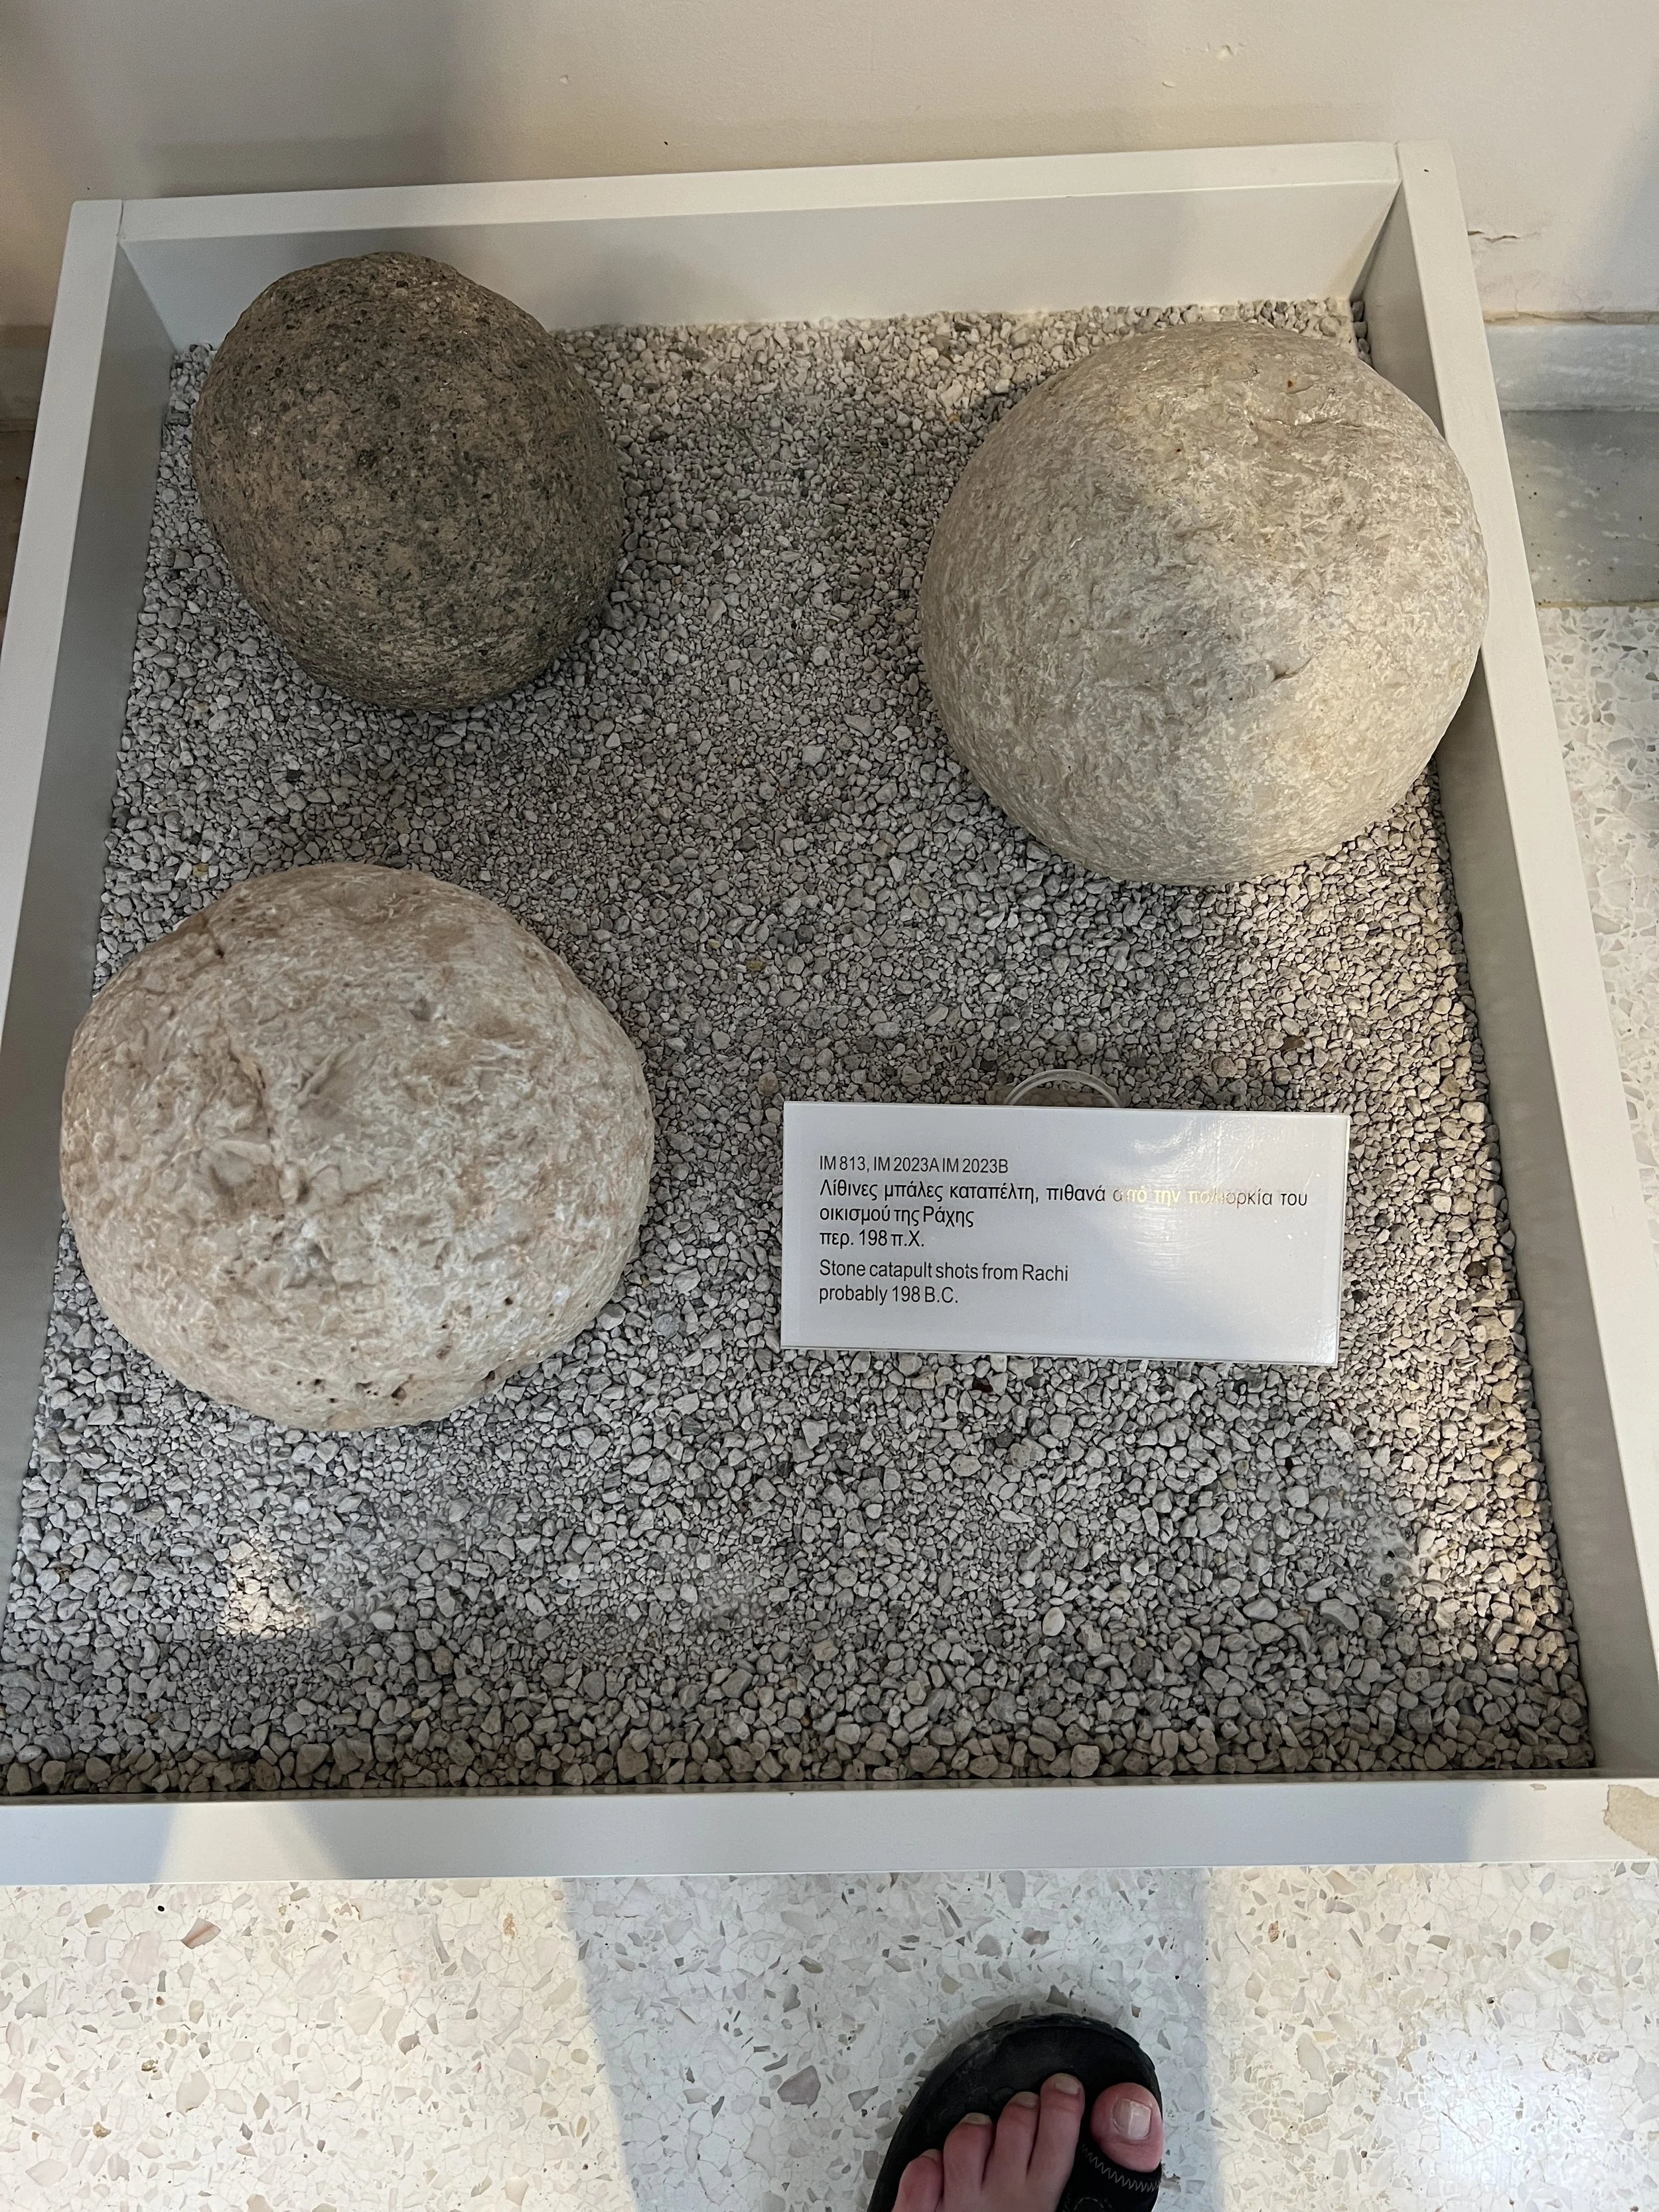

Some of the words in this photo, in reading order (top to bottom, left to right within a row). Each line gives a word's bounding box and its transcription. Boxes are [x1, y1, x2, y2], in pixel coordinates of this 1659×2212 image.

[820, 1156, 836, 1170] IM
[839, 1156, 869, 1173] 813,
[873, 1157, 890, 1171] IM
[820, 1179, 877, 1201] Λίθινες
[885, 1181, 943, 1201] μπάλες
[950, 1183, 1039, 1203] καταπέλτη,
[1046, 1184, 1106, 1202] πιθανά
[1279, 1192, 1308, 1206] του
[820, 1205, 890, 1225] οικισμού
[894, 1209, 919, 1226] της
[923, 1205, 974, 1227] Ράχης
[820, 1232, 854, 1249] περ.
[859, 1230, 887, 1246] 198
[891, 1230, 924, 1247] π.Χ.
[820, 1259, 865, 1276] Stone
[869, 1262, 932, 1282] catapult
[936, 1262, 978, 1279] shots
[982, 1262, 1017, 1280] from
[1022, 1264, 1068, 1282] Rachi
[820, 1284, 887, 1305] probably
[892, 1286, 920, 1302] 198
[924, 1286, 958, 1303] B.C.
